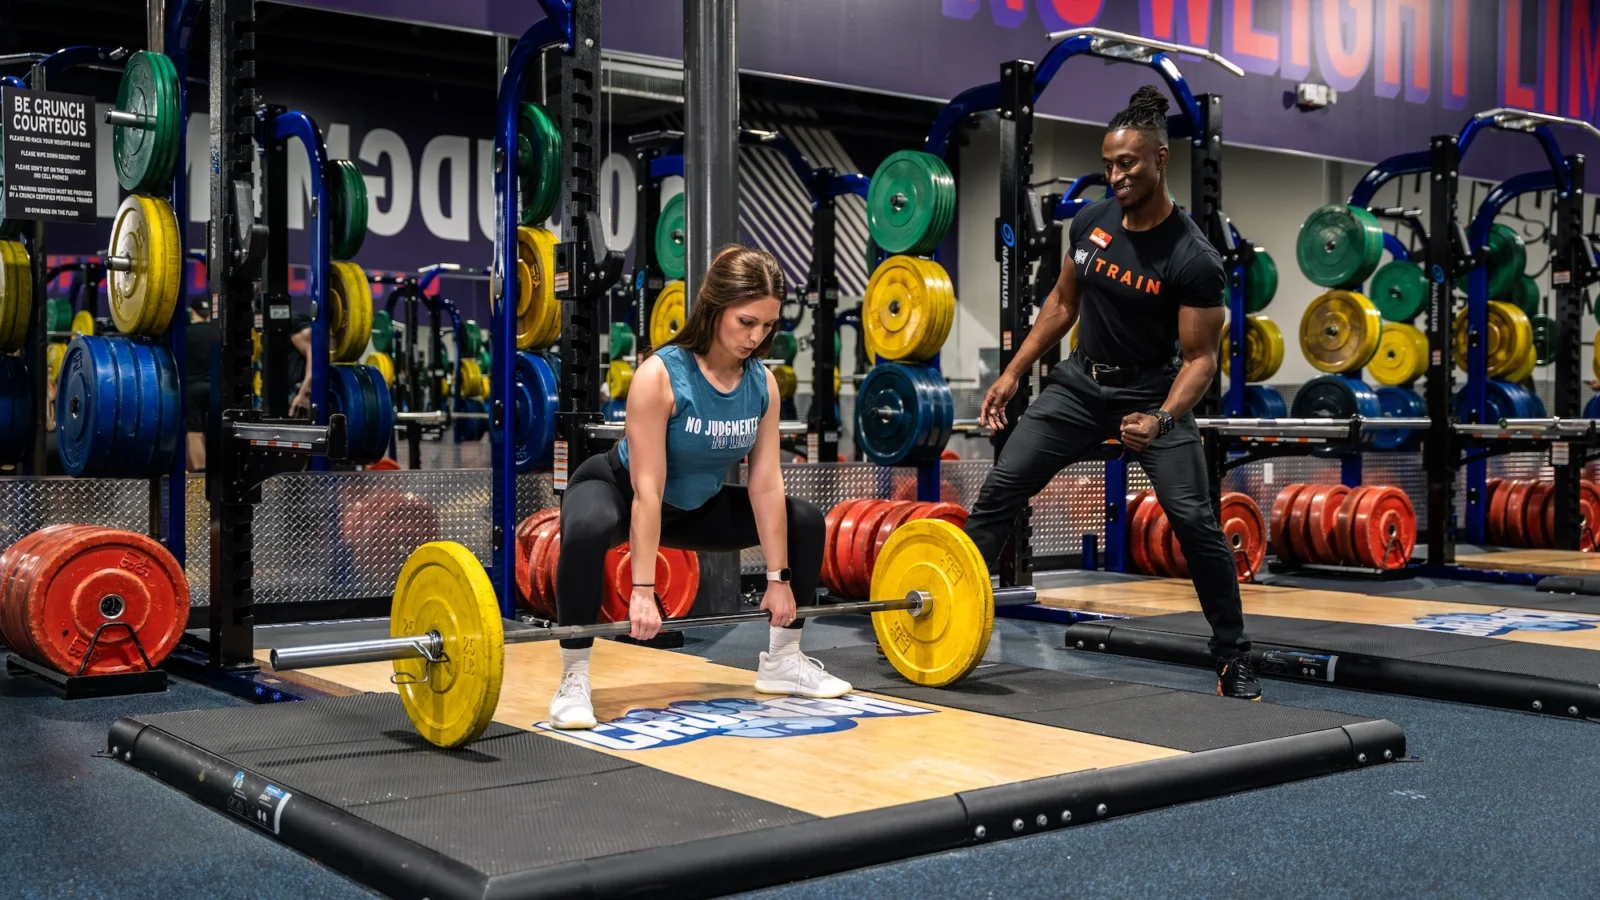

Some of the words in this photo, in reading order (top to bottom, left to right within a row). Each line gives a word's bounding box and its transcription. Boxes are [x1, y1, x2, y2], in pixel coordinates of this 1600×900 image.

[14, 96, 31, 113] BE
[34, 98, 85, 119] CRUNCH
[13, 114, 87, 136] COURTEOUS
[9, 134, 25, 142] PLEASE
[14, 163, 31, 171] PLEASE
[64, 168, 87, 176] EQUIPMENT
[18, 192, 36, 200] CRUNCH
[35, 193, 56, 201] CERTIFIED
[55, 195, 77, 203] PERSONAL
[37, 186, 56, 194] SERVICES
[73, 189, 92, 197] PROVIDED
[1095, 257, 1161, 295] TRAIN
[1431, 282, 1439, 332] NAUTILUS
[685, 416, 702, 434] NO
[711, 434, 728, 450] NO
[463, 636, 476, 656] 25
[462, 656, 475, 676] LB
[534, 694, 941, 751] CRUNCH
